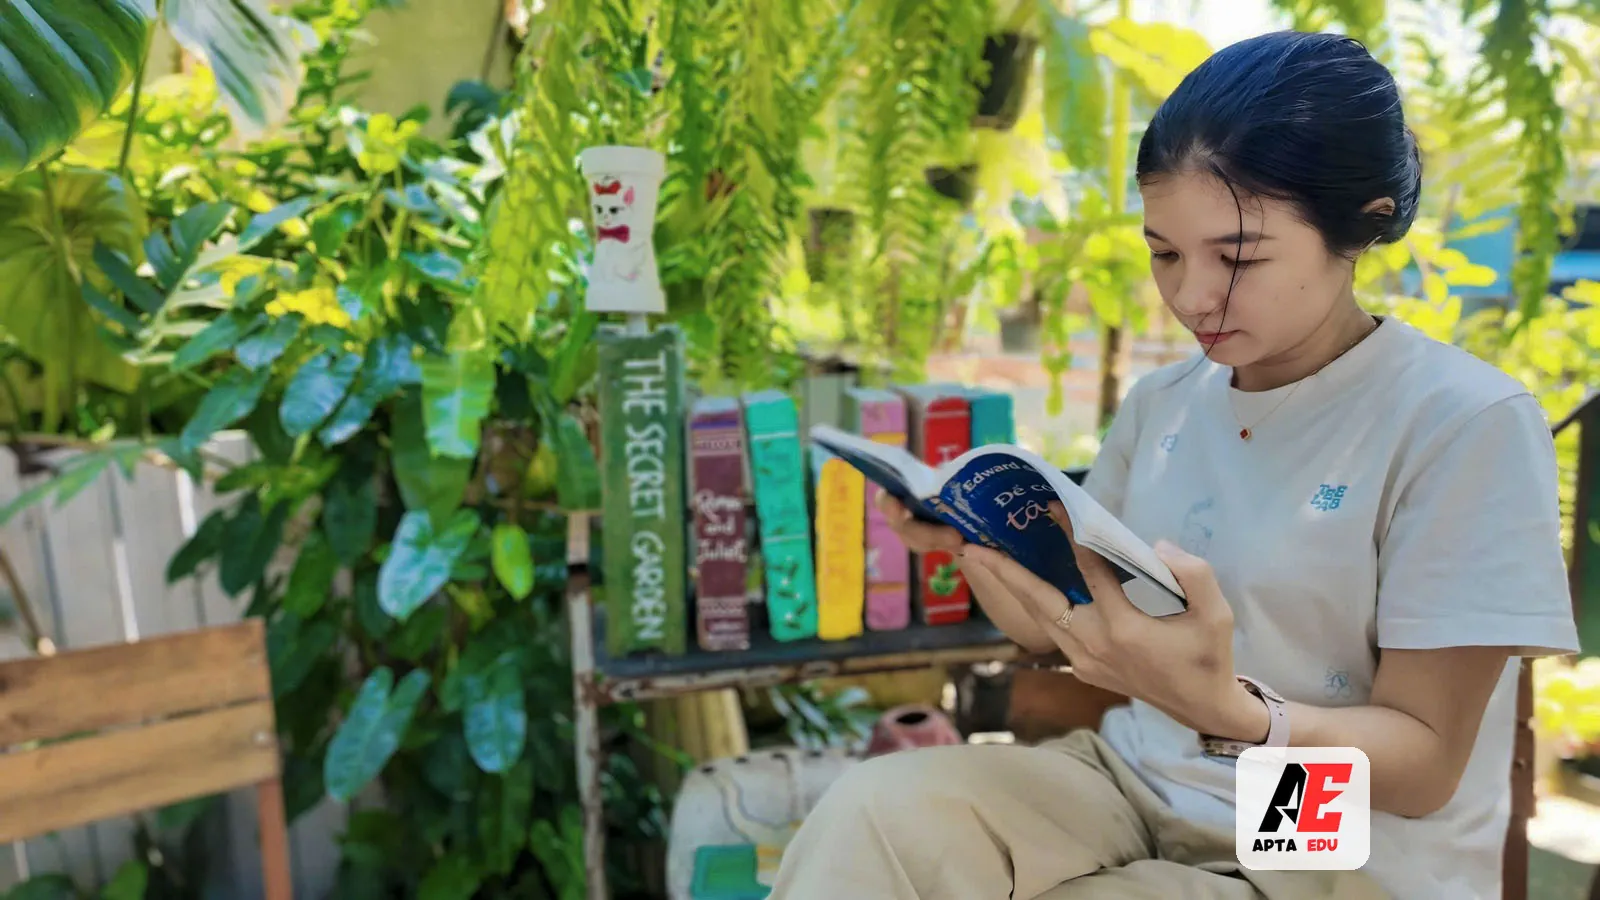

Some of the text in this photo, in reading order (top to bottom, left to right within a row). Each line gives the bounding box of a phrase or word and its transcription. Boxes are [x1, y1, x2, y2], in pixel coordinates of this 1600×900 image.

[962, 462, 1020, 493] Edward
[622, 350, 668, 640] THE SECRET GARDEN
[703, 513, 736, 535] and
